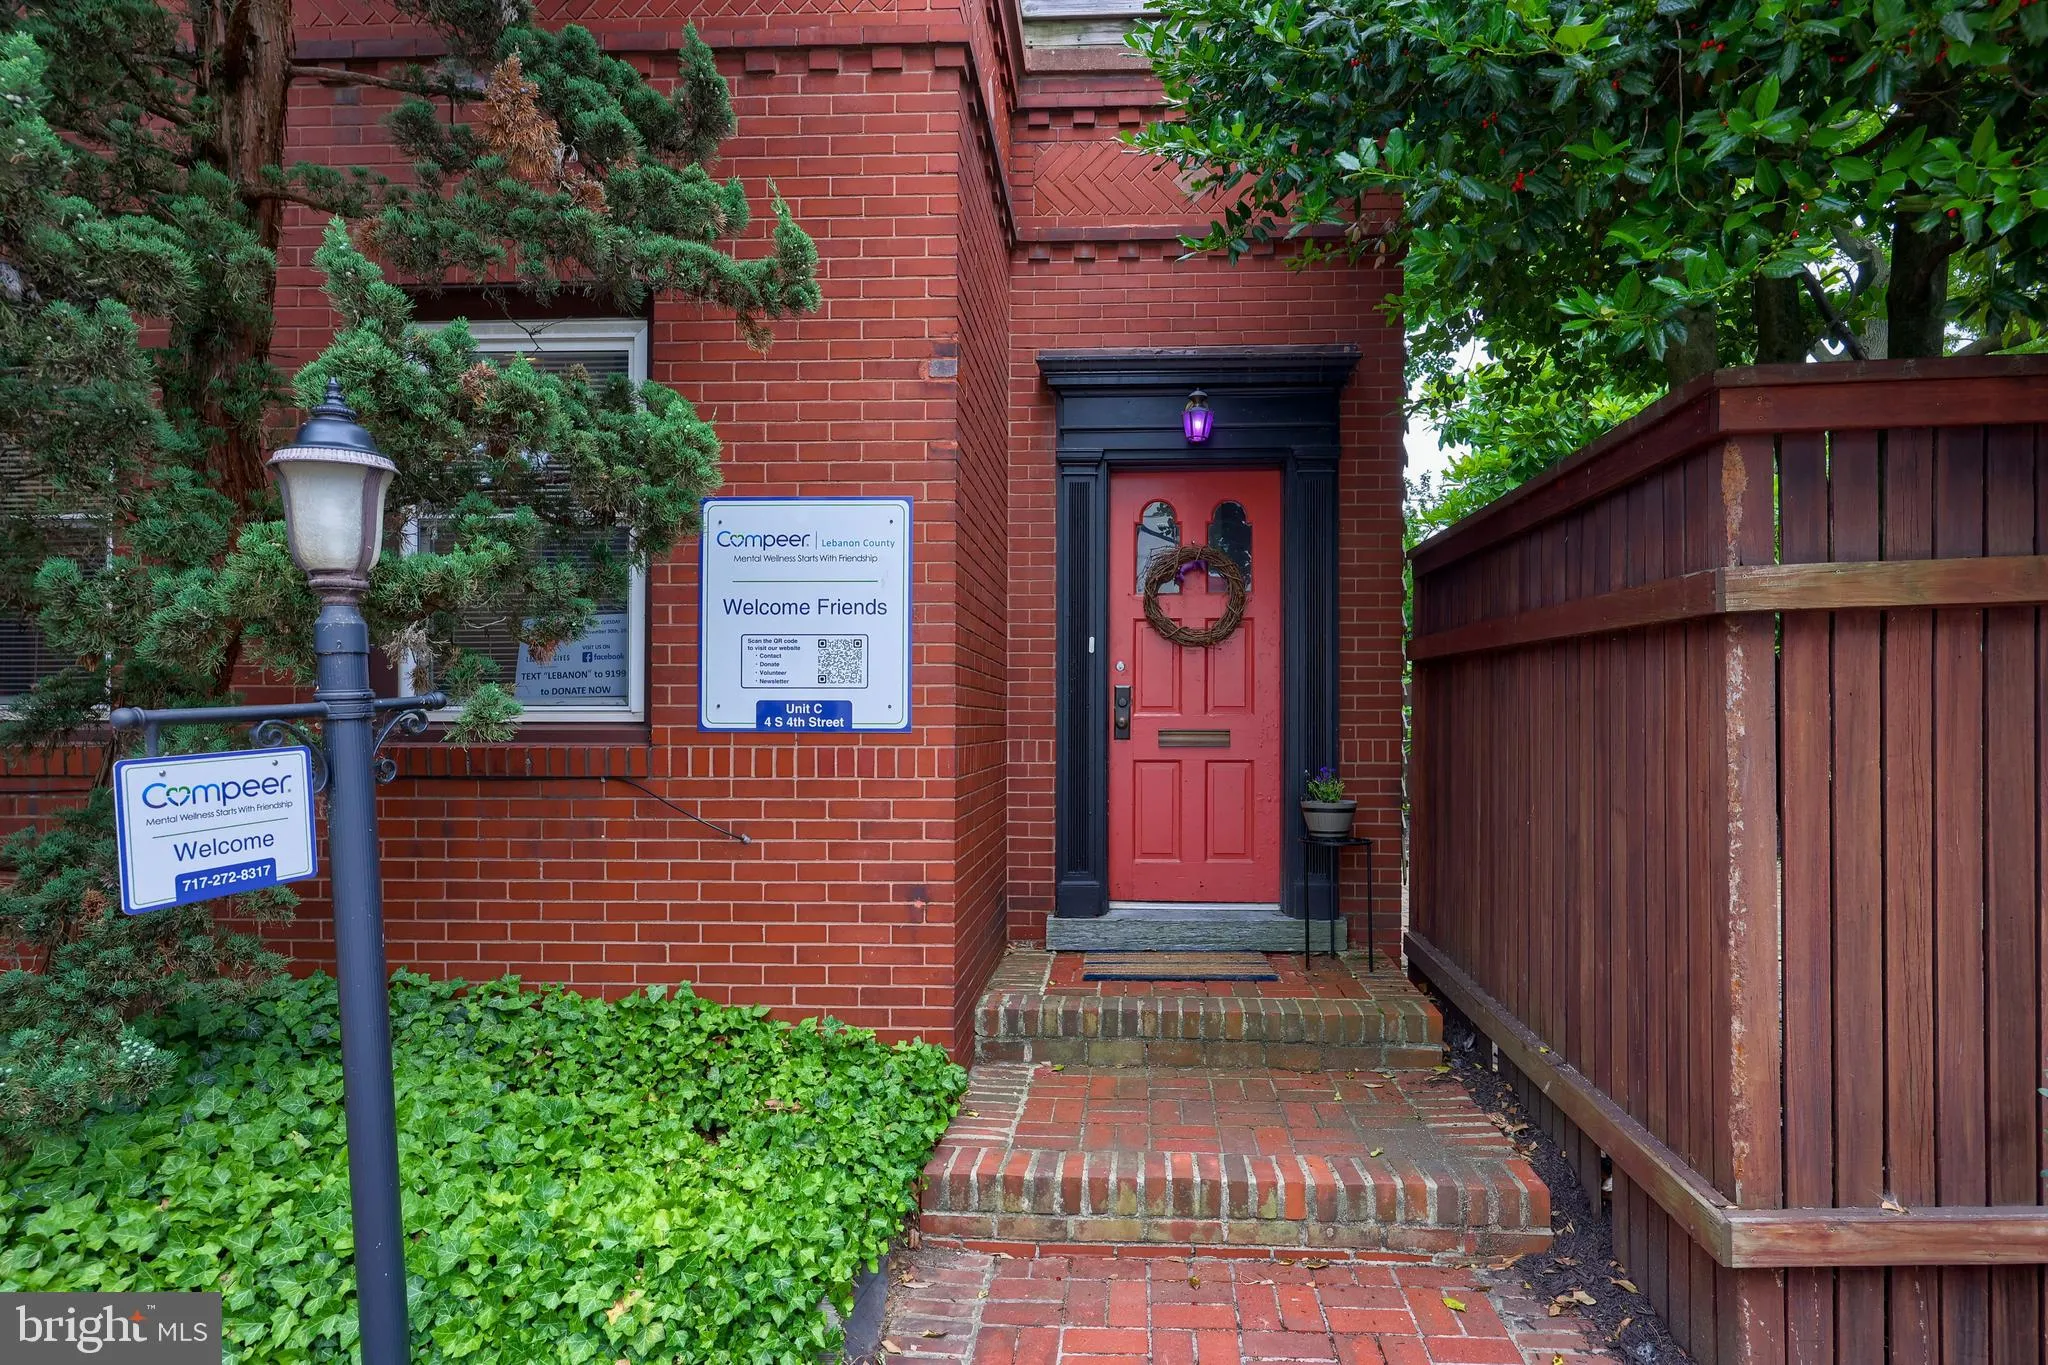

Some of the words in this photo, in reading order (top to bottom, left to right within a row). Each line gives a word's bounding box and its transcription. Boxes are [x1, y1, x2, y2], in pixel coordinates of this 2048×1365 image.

[716, 530, 811, 551] Compeer
[821, 538, 860, 548] Lebanon
[863, 538, 896, 549] County
[733, 554, 762, 563] Mental
[763, 554, 796, 563] Wellness
[797, 554, 819, 563] Starts
[819, 554, 837, 563] With
[838, 554, 878, 564] Friendship
[723, 598, 811, 615] Welcome
[817, 598, 888, 615] Friends
[593, 652, 625, 661] facebook
[521, 672, 541, 681] TEXT
[540, 688, 550, 696] to
[551, 686, 587, 696] DONATE
[588, 685, 612, 695] NOW
[785, 703, 811, 714] Unit
[813, 703, 823, 714] C
[764, 716, 772, 728] 4
[774, 716, 783, 728] S
[786, 716, 805, 728] 4th
[806, 716, 845, 728] Street
[142, 774, 293, 809] Compeer
[145, 814, 179, 827] Mental
[179, 810, 215, 822] Wellness
[215, 807, 238, 817] Starts
[237, 804, 256, 814] With
[256, 800, 294, 812] Friendship
[173, 832, 275, 862] Welcome
[182, 864, 272, 892] 717-272-8317
